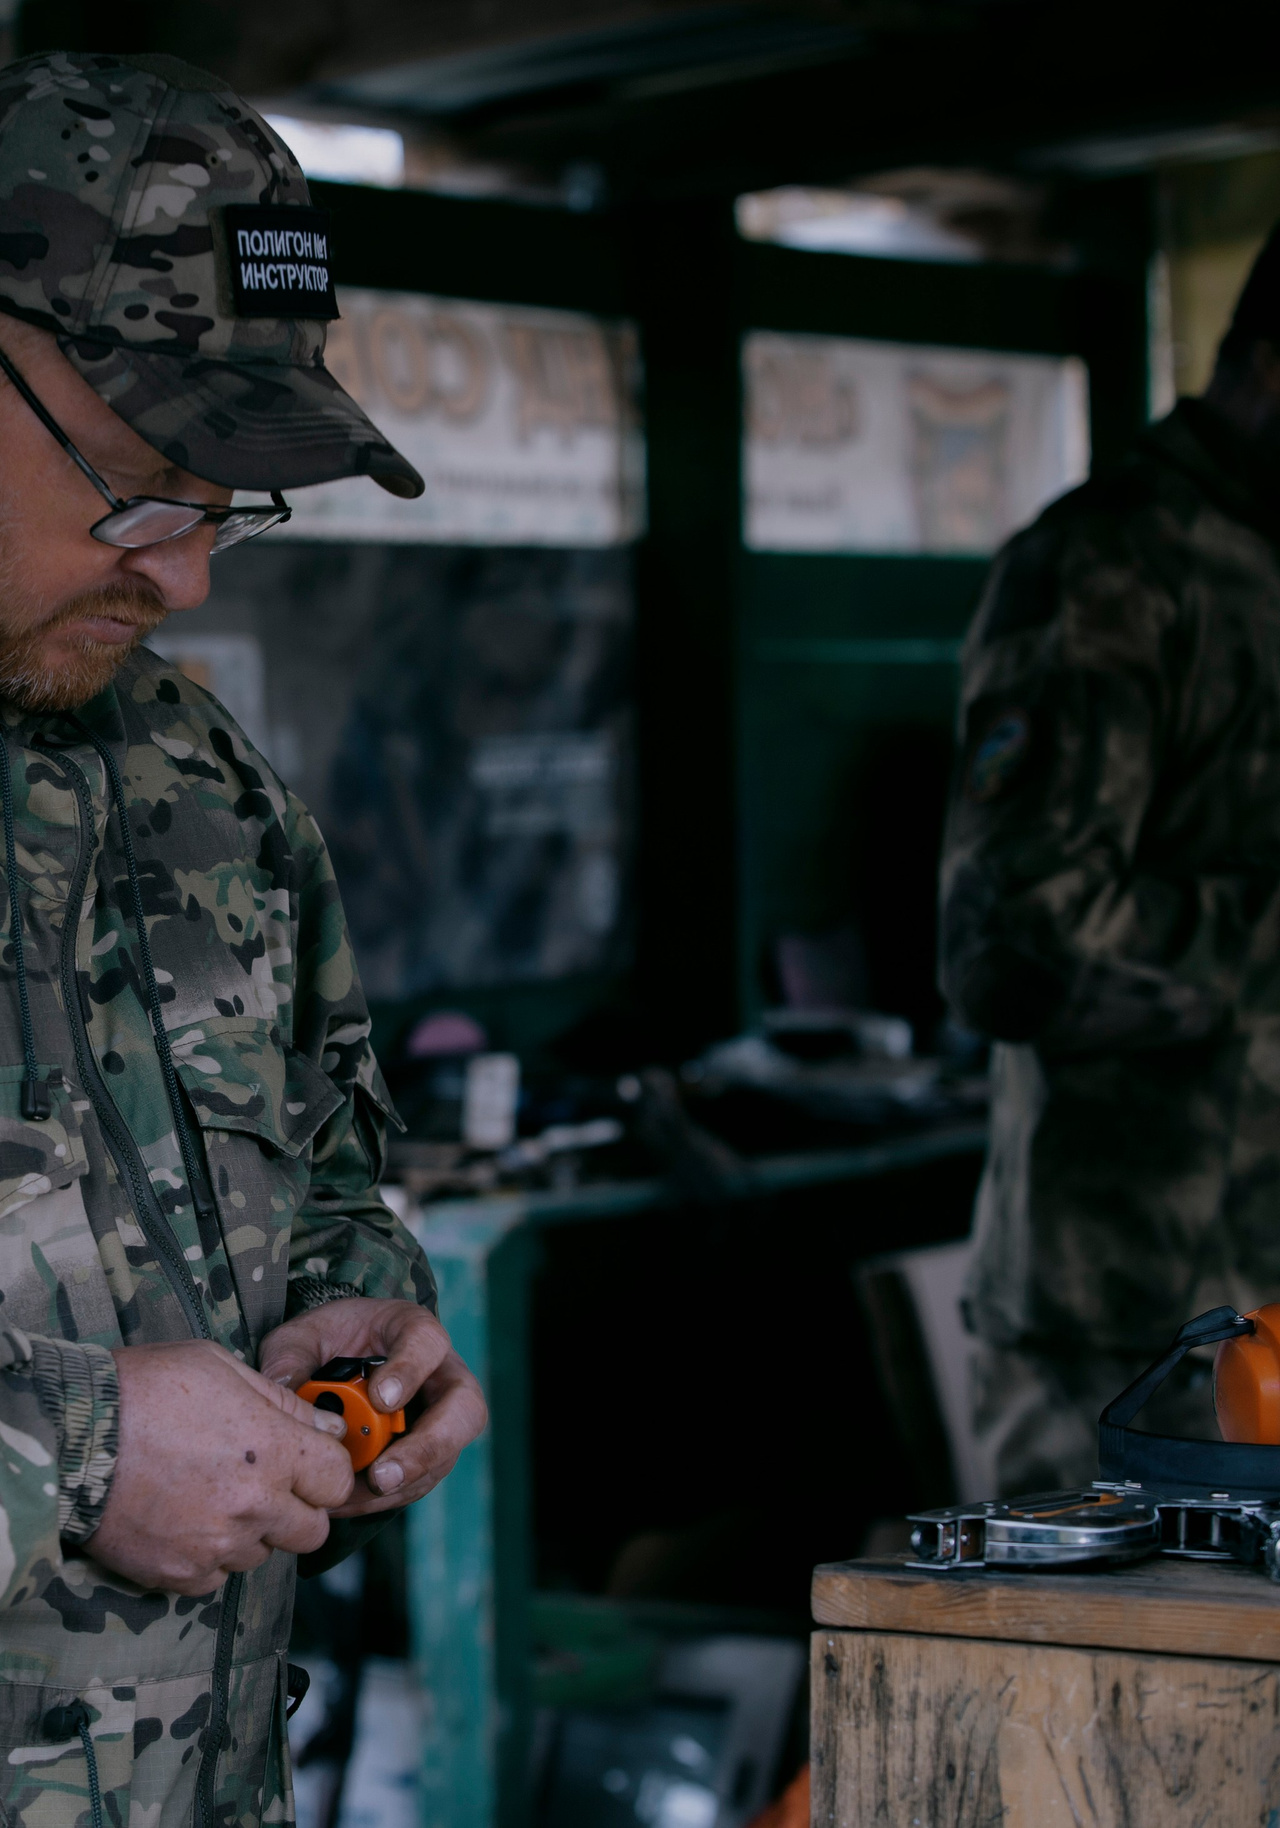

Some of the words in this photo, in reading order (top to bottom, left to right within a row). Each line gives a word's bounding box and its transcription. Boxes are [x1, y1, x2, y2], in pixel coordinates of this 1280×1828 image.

[237, 230, 312, 258] ПОЛИГОН
[313, 233, 328, 260] №1
[240, 262, 329, 293] ИНСТРУКТОР
